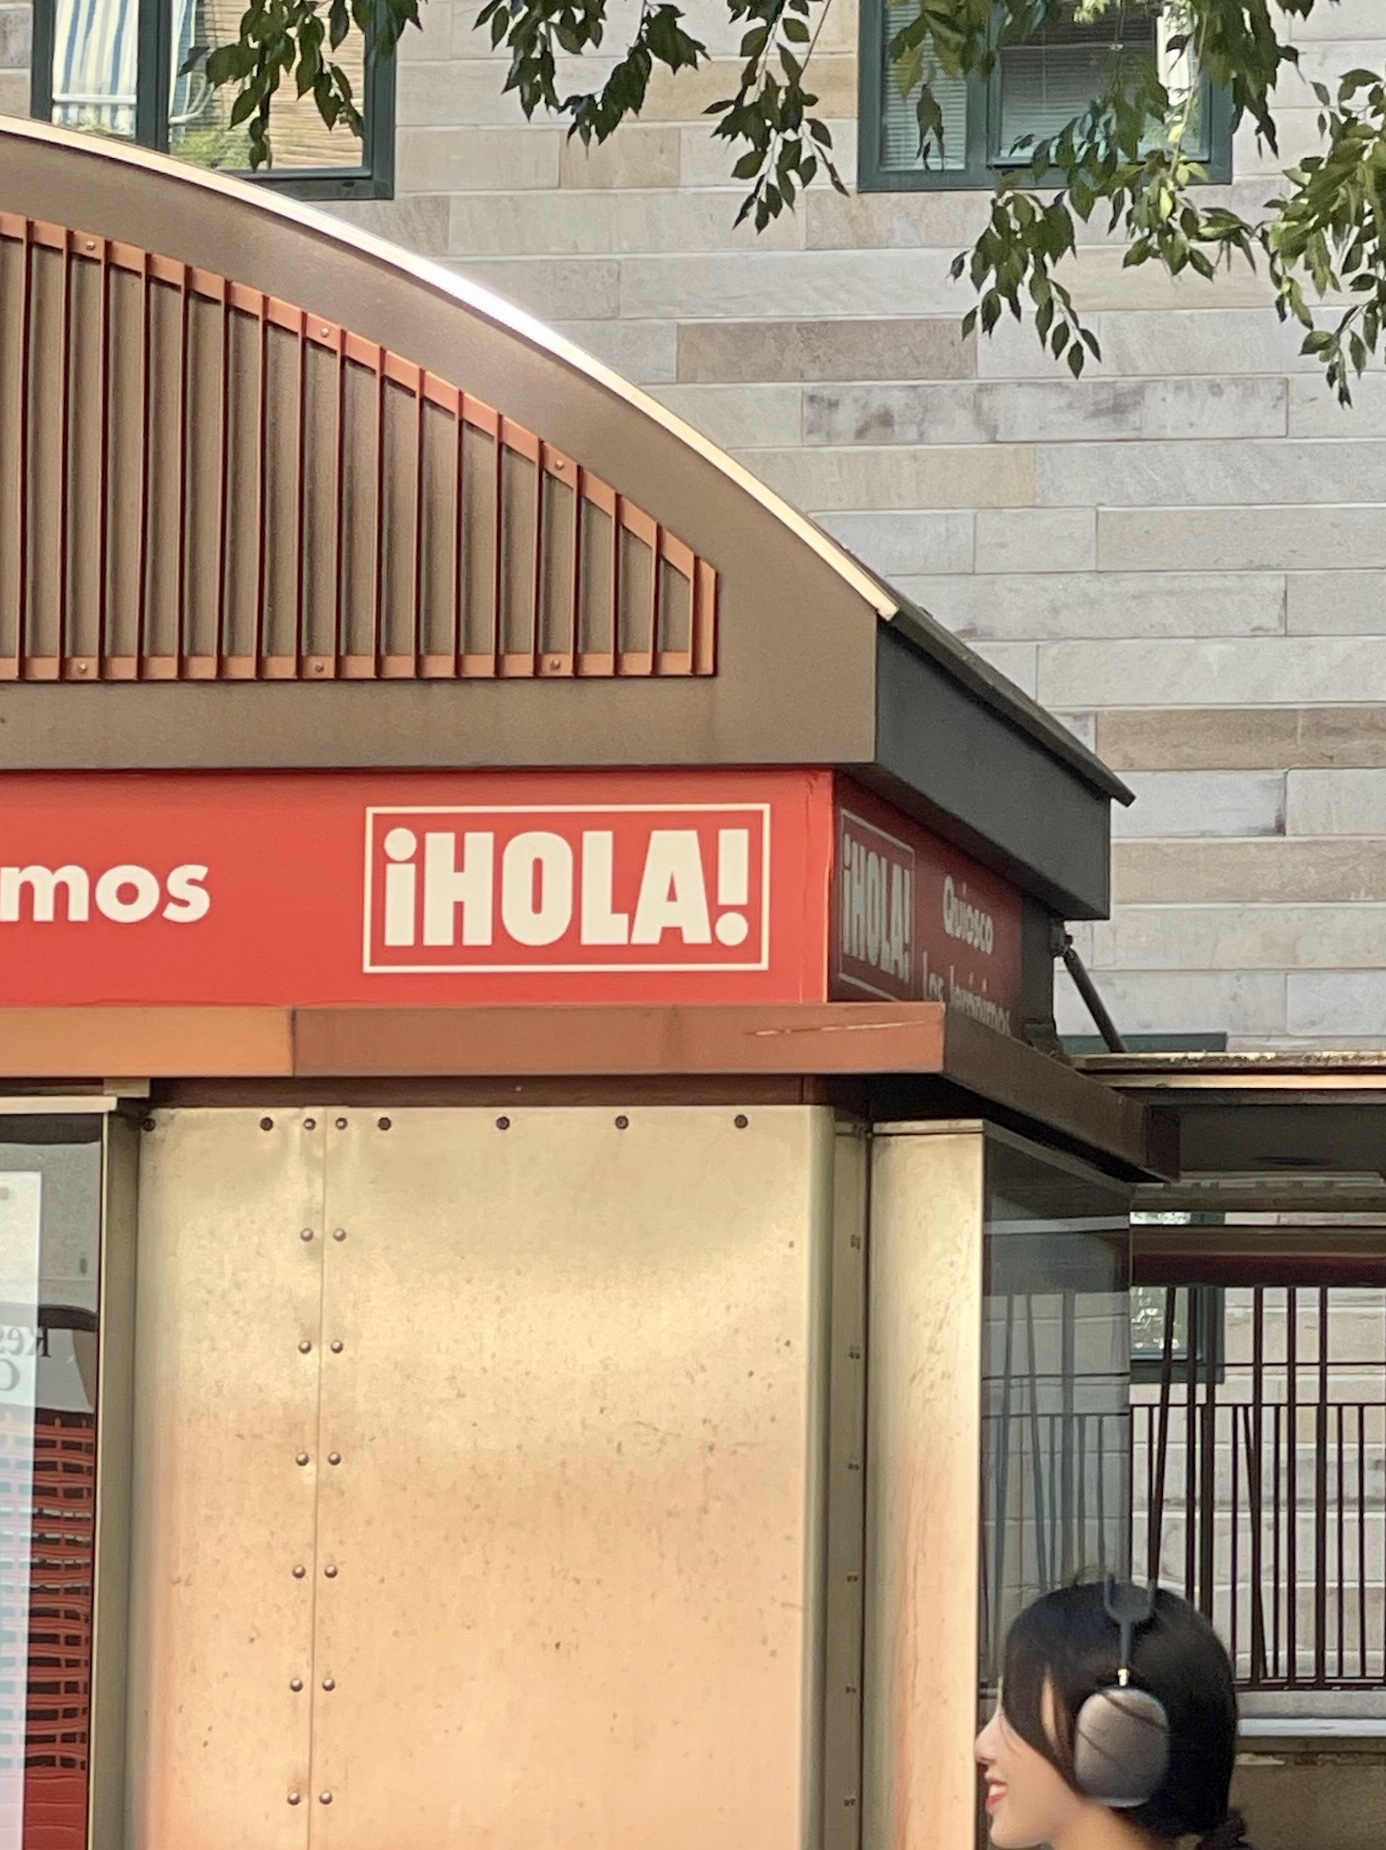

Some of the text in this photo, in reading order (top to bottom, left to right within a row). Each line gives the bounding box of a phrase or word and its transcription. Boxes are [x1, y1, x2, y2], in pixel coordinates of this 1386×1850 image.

[384, 827, 749, 946] ¡HOLA!
[843, 833, 910, 984] ¡HOLA!
[943, 875, 993, 955] Quiosco
